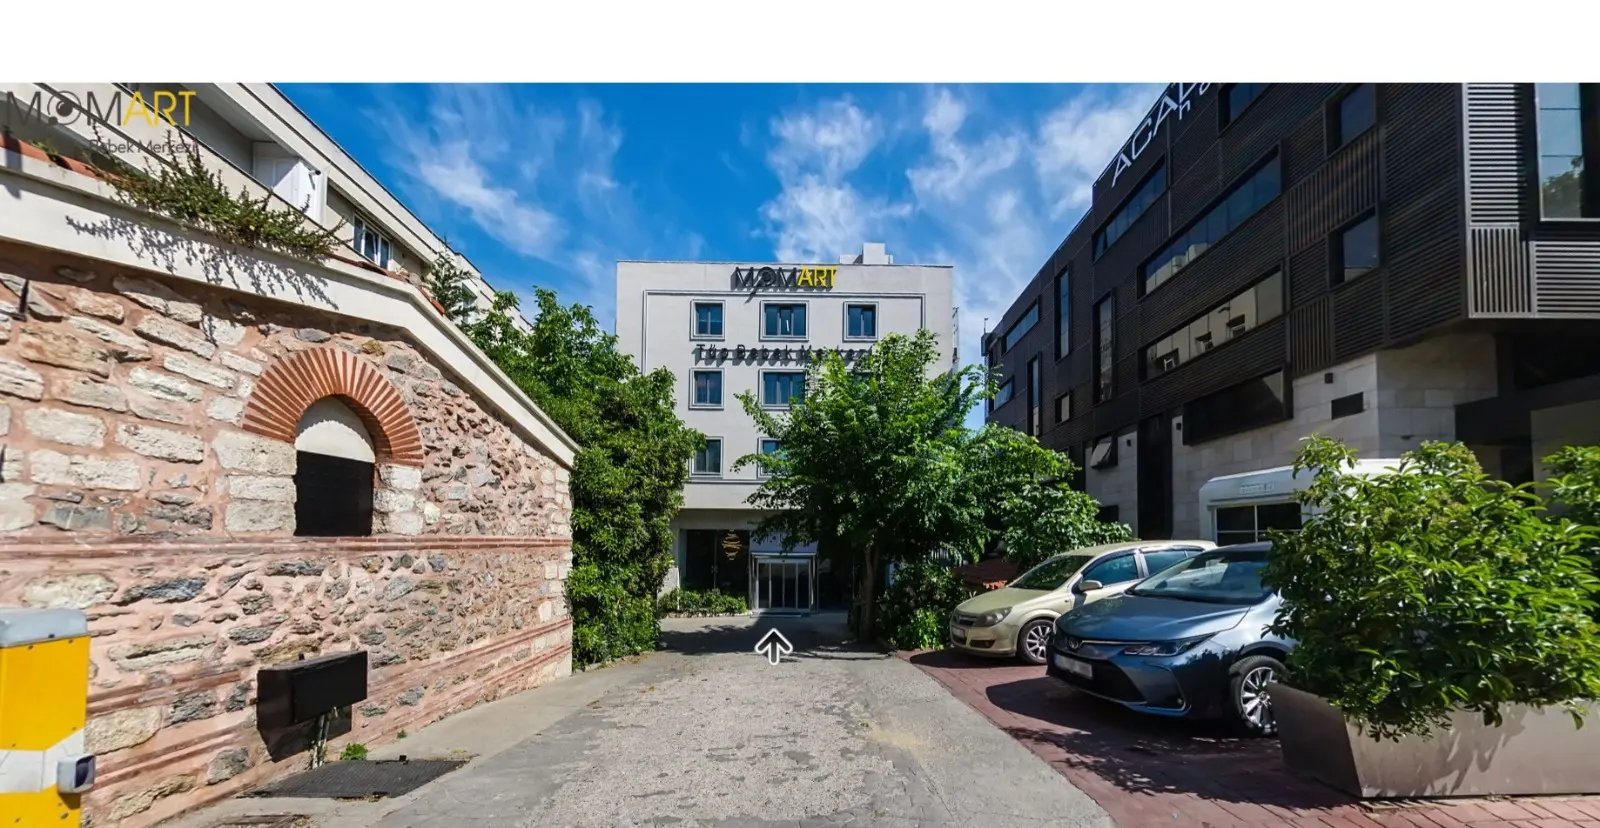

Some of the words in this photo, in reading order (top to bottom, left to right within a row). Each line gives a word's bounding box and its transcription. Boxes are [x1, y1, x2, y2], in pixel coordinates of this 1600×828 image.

[735, 265, 838, 288] MOMART
[696, 344, 728, 361] Tüp
[737, 344, 793, 360] Bebek
[801, 344, 873, 361] Mekez
